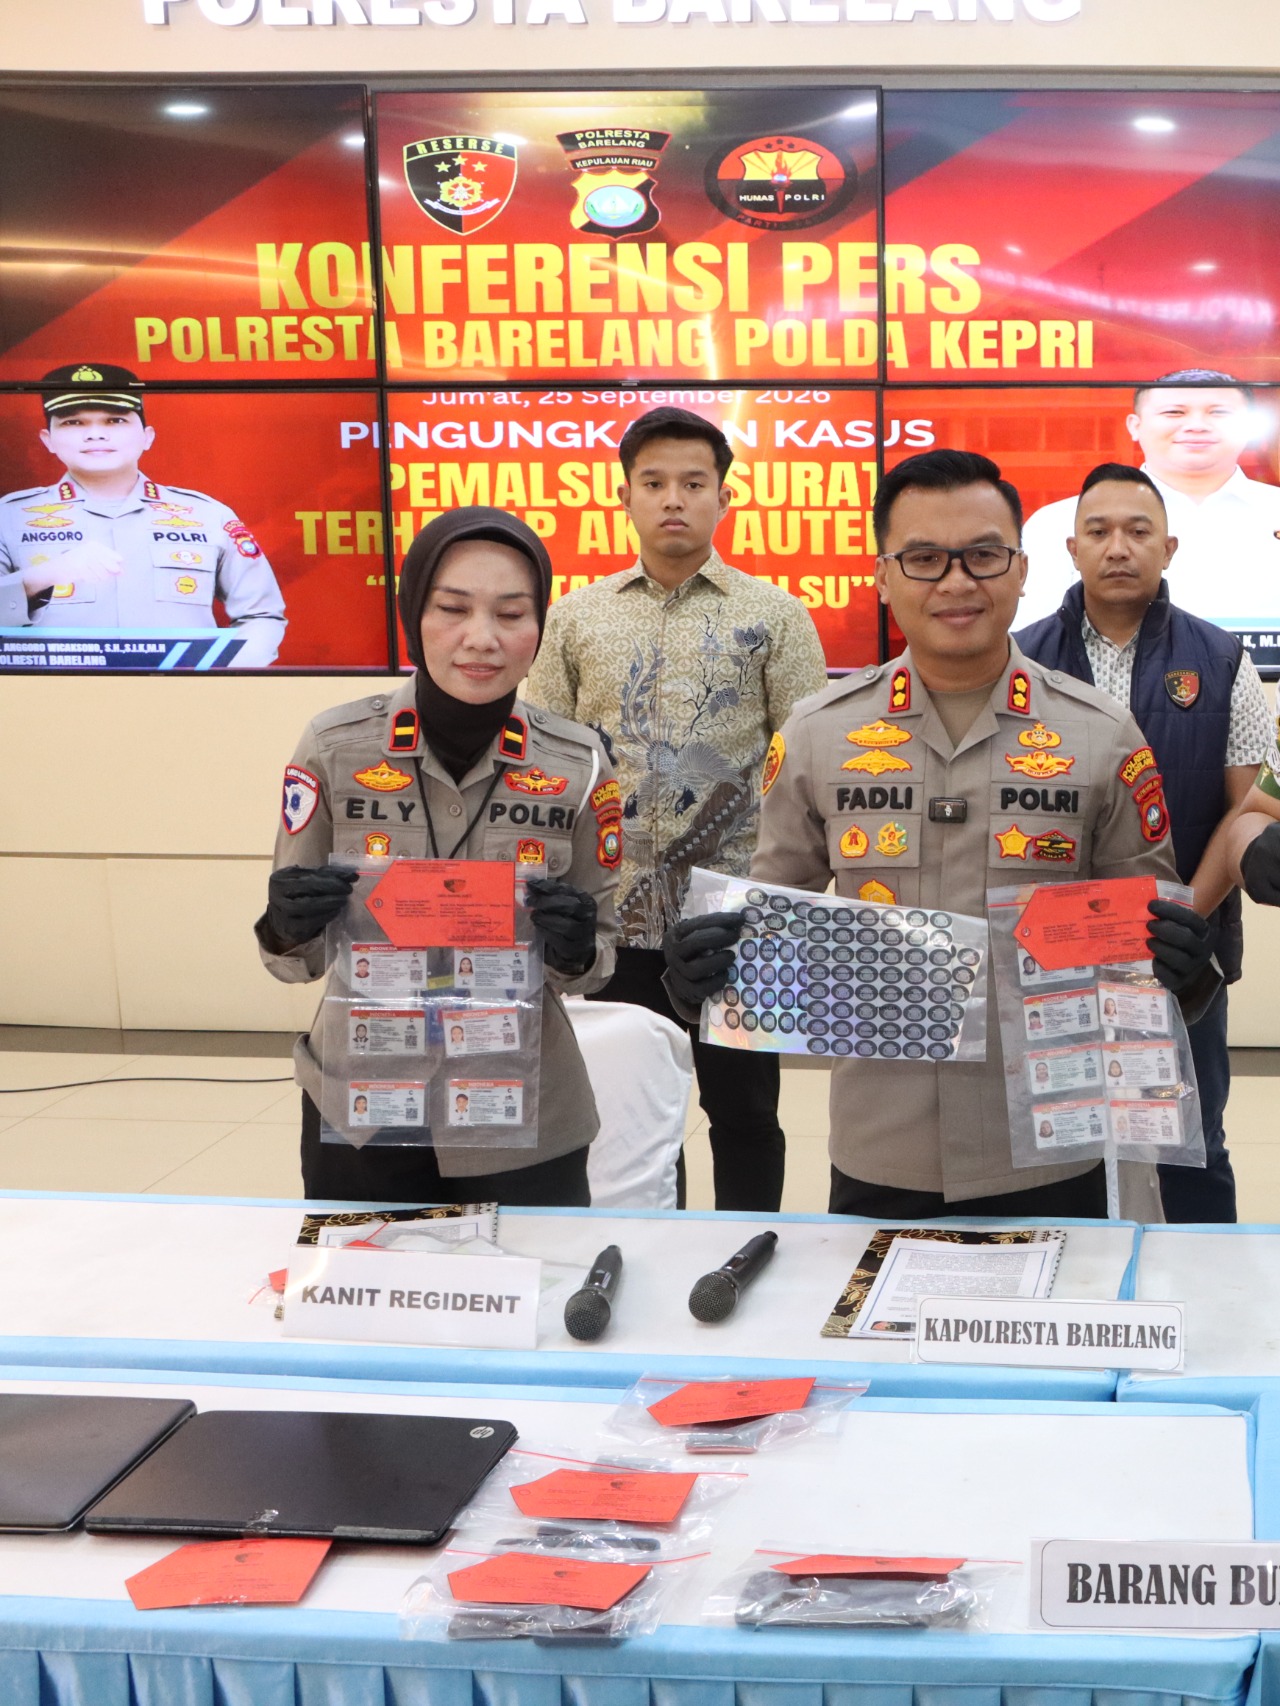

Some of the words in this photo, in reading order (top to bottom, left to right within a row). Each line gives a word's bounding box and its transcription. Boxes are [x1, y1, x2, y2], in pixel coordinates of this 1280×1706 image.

[417, 136, 505, 155] RESERSE
[574, 130, 651, 142] POLRESTA
[578, 138, 646, 149] BARELANG
[575, 157, 630, 168] KEPULAUAN
[631, 158, 654, 168] RIAU
[739, 194, 775, 202] HUMAS
[784, 193, 825, 201] POLRI
[255, 242, 749, 313] KONFERENSI
[781, 242, 982, 314] PERS
[134, 315, 401, 369] POLRESTA
[425, 319, 708, 369] BARELANG
[735, 319, 909, 369] POLDA
[930, 320, 1095, 369] KEPRI
[422, 390, 531, 408] Jum'at,
[538, 390, 574, 405] 25
[582, 389, 743, 407] September
[754, 389, 831, 404] 2026
[724, 461, 880, 508] SURAT
[21, 531, 84, 543] ANGGORO
[153, 532, 208, 543] POLRI
[49, 655, 107, 666] BARELANG
[836, 787, 913, 811] FADLI
[1000, 788, 1079, 813] POLRI
[489, 802, 576, 831] POLRI
[301, 1285, 381, 1308] KANIT
[388, 1290, 521, 1314] REGIDENT
[924, 1317, 1060, 1346] KAPOLRESTA
[1066, 1322, 1177, 1350] BARELANG
[1066, 1562, 1216, 1606] BARANG
